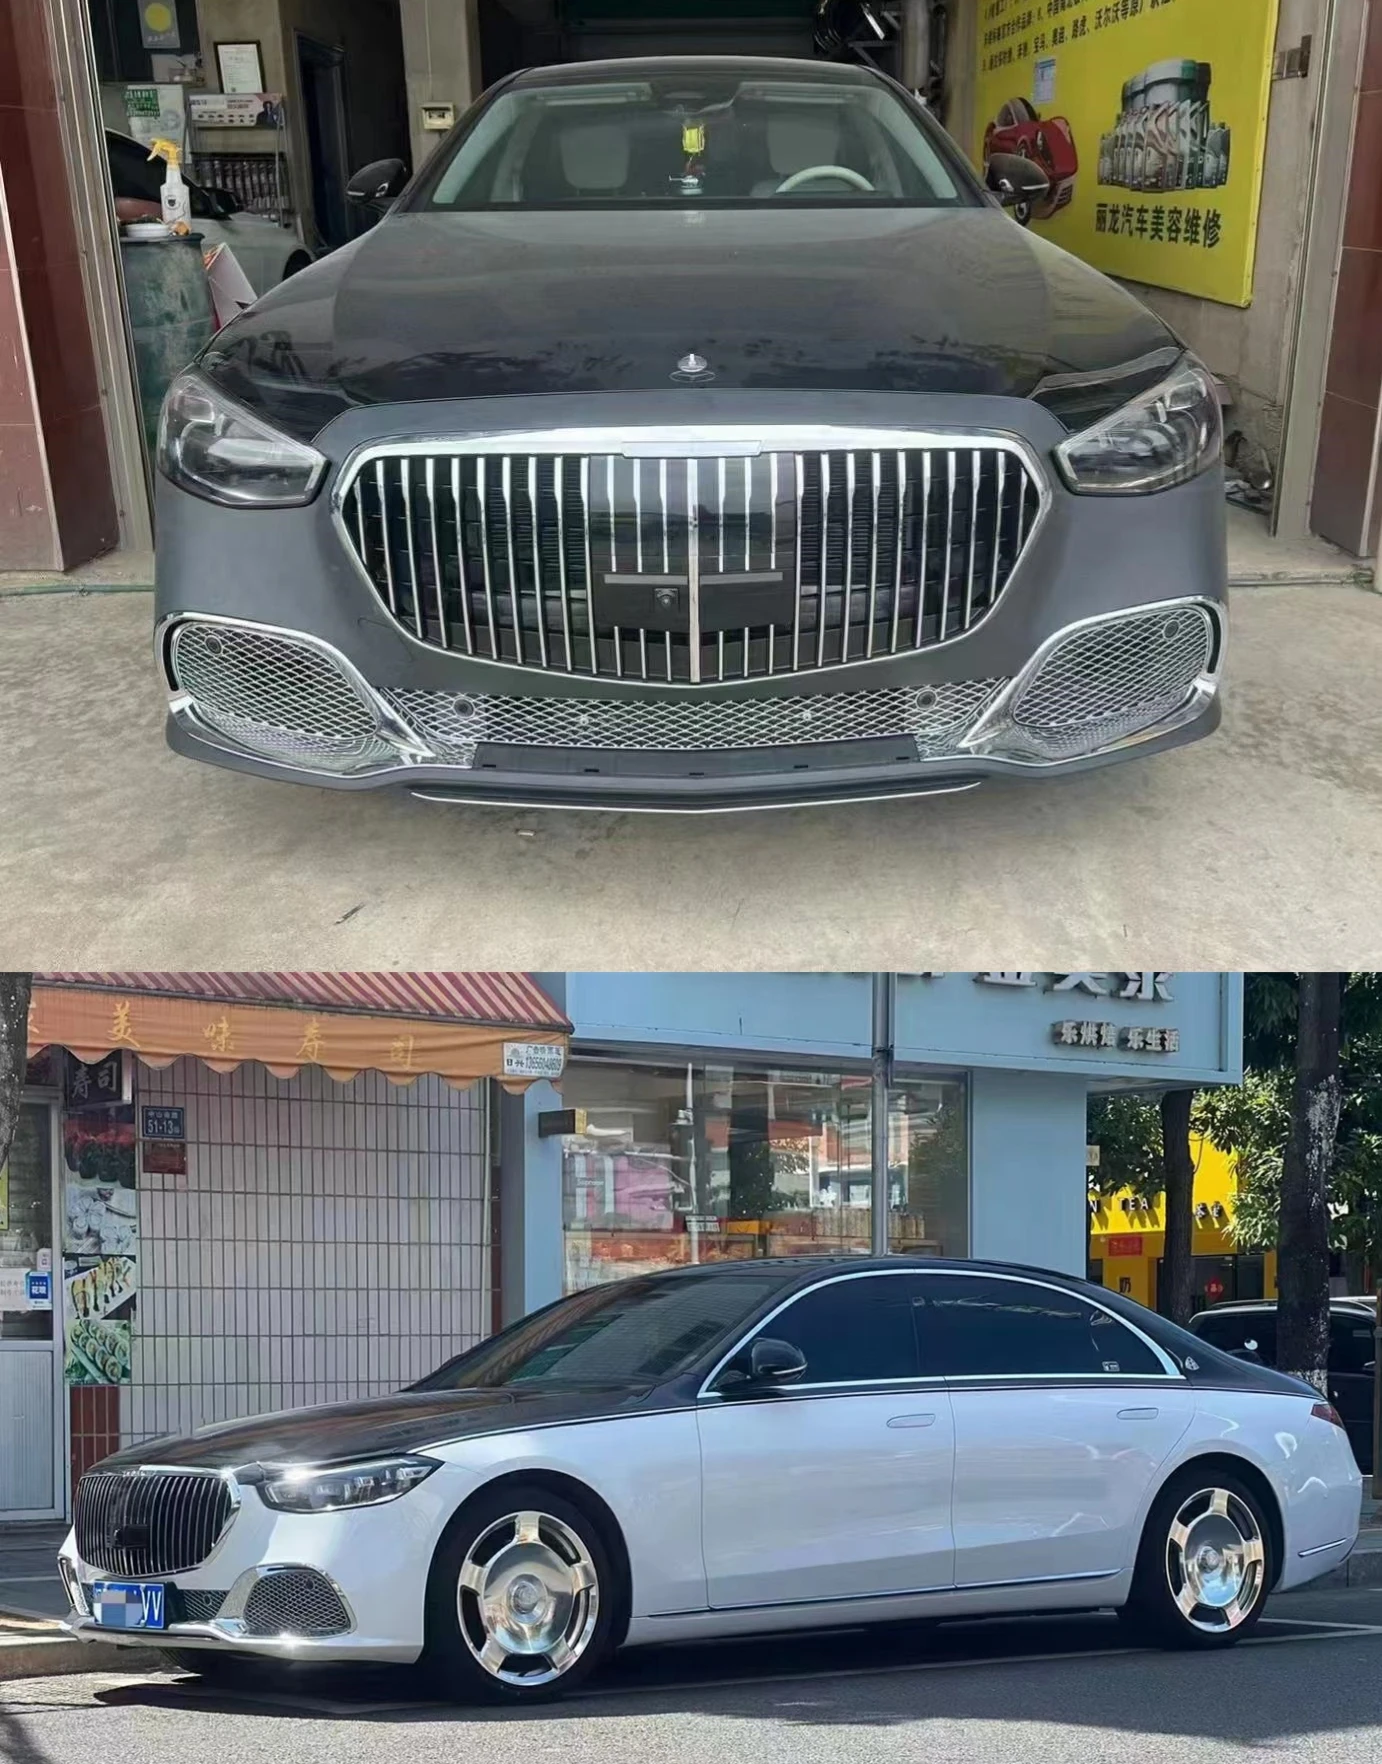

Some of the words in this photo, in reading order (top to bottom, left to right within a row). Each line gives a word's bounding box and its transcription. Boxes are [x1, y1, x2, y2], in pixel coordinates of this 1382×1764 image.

[1096, 203, 1221, 249] 丽龙汽车美容维修
[1127, 1028, 1179, 1052] 乐生活
[72, 1062, 117, 1099] 寿司
